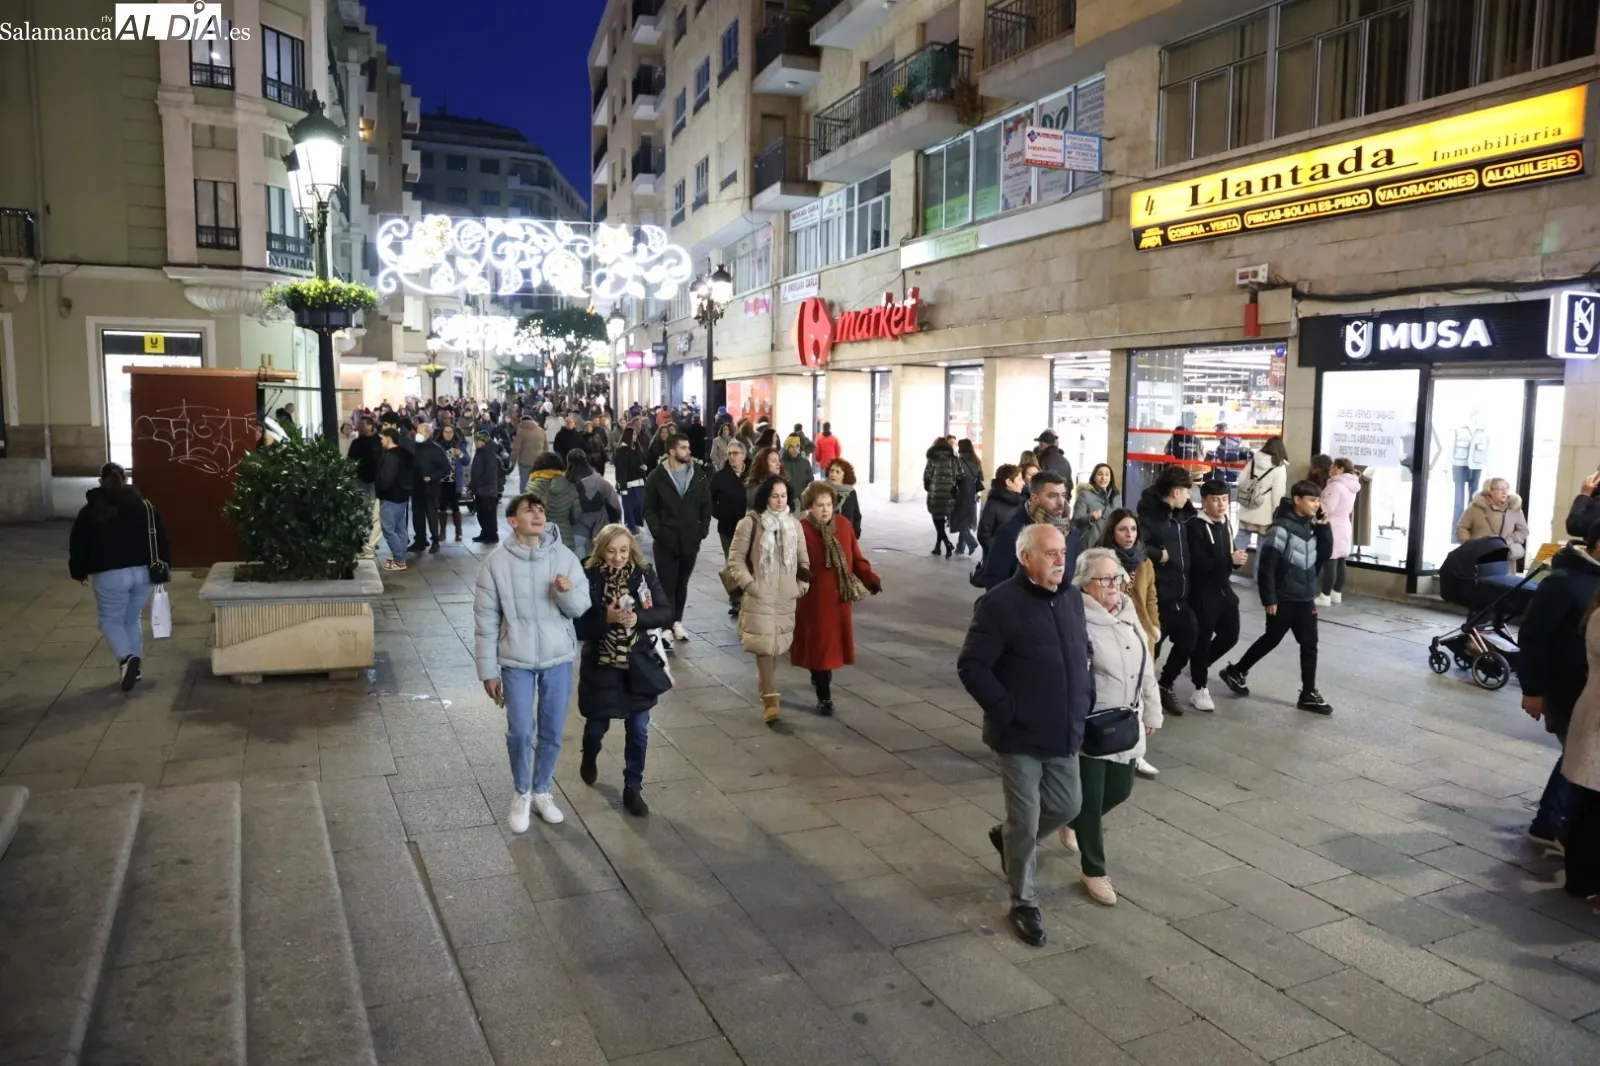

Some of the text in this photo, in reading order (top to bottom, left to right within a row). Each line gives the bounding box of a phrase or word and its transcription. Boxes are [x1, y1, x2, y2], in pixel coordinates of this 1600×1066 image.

[1432, 126, 1563, 162] Inmobiliaria
[1188, 145, 1397, 207] Llantada
[1486, 155, 1577, 182] ALQUILERES
[1378, 173, 1475, 201] VALORACIONES
[1170, 224, 1205, 239] COMPRA
[1210, 218, 1238, 232] VENTA
[836, 286, 919, 342] market
[1379, 319, 1492, 350] MUSA
